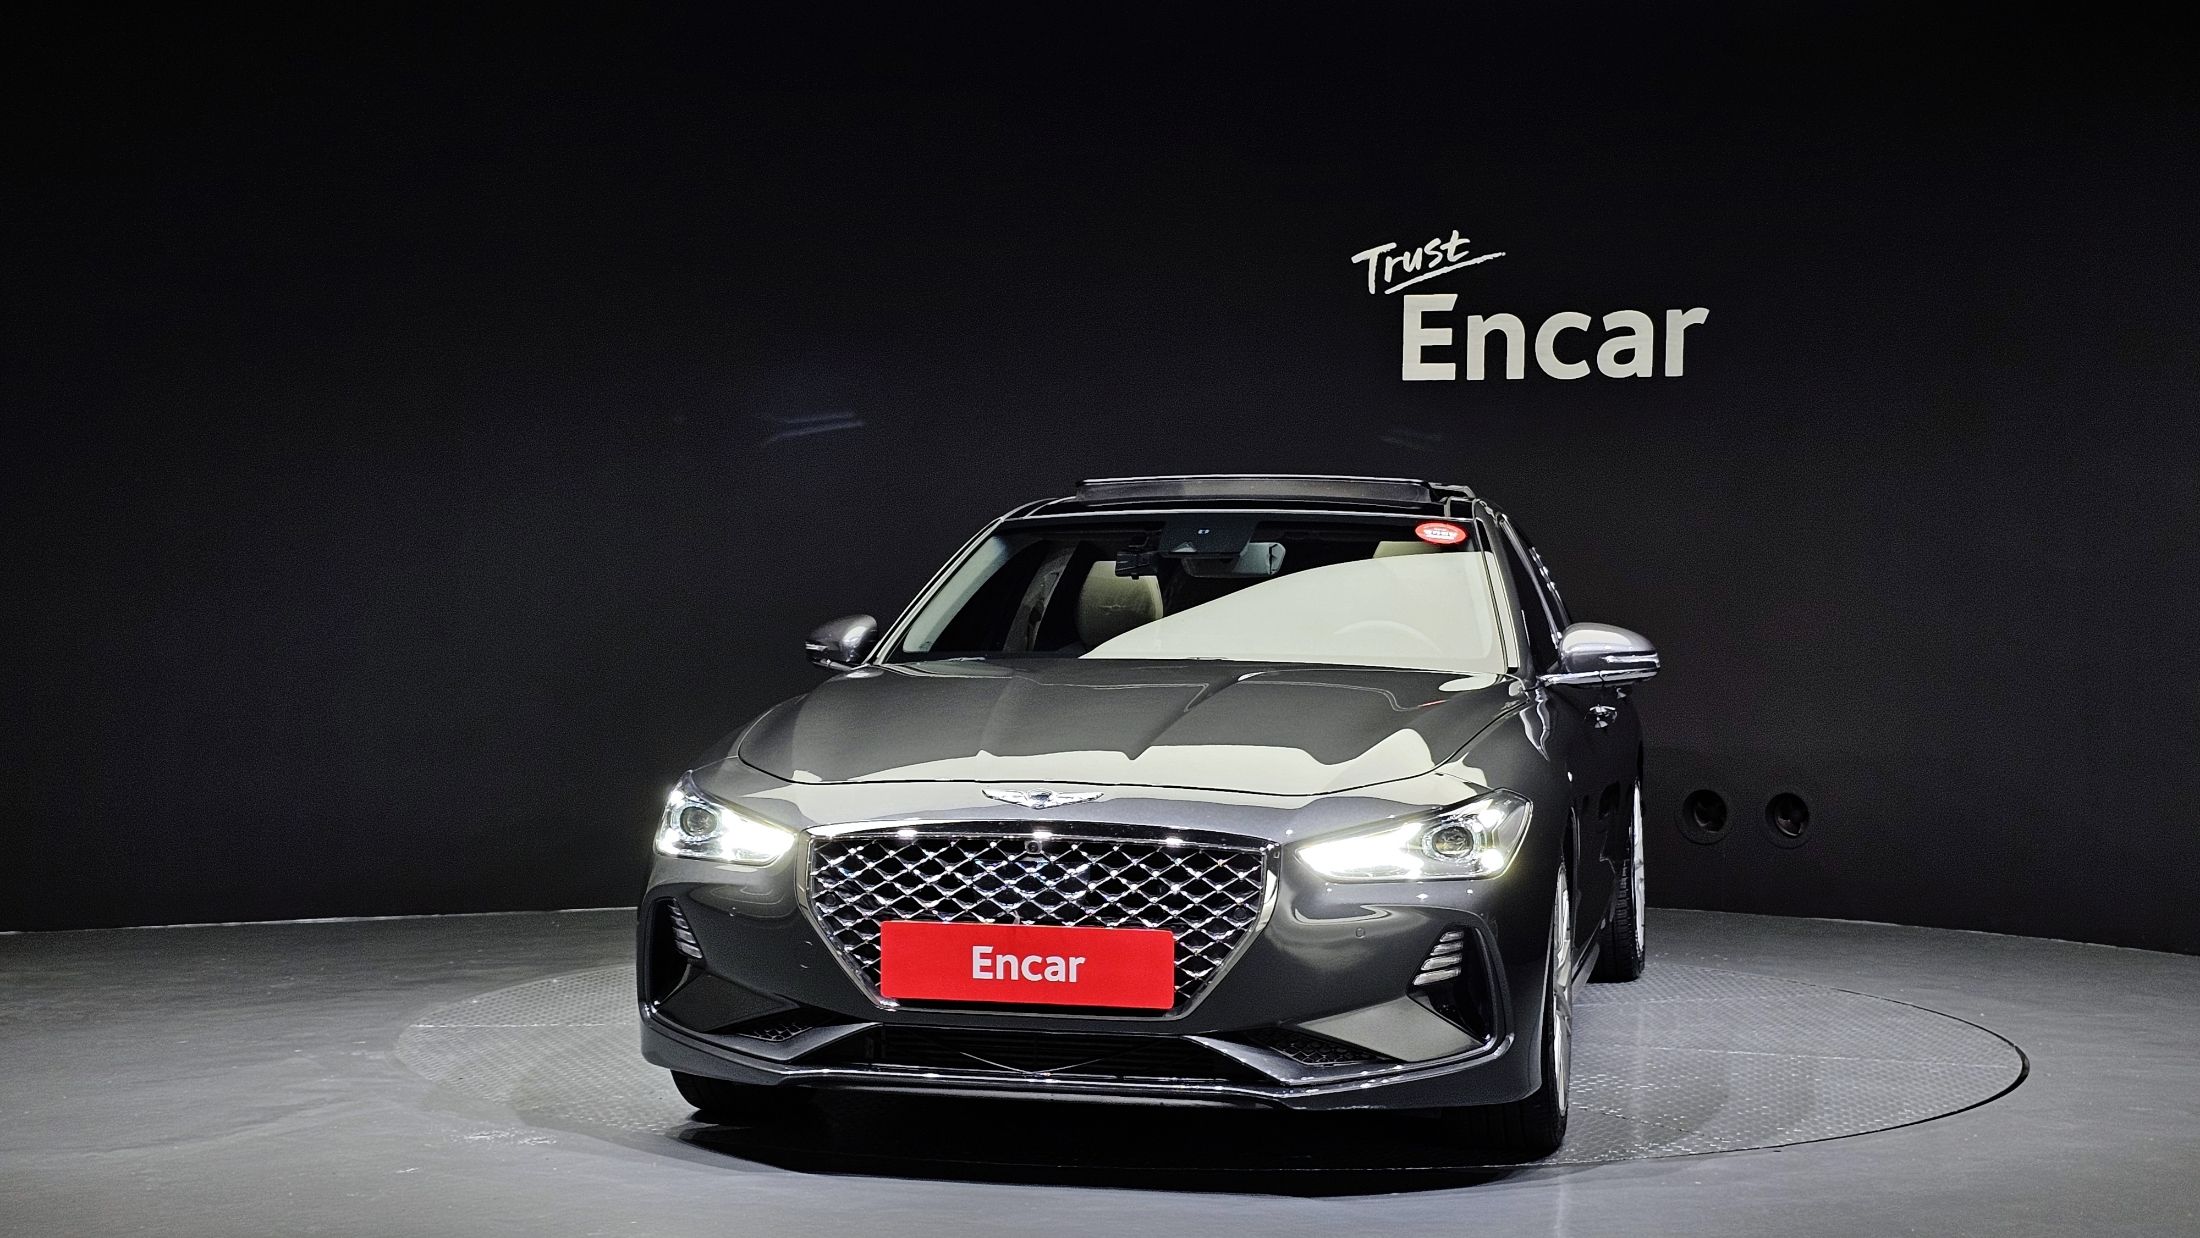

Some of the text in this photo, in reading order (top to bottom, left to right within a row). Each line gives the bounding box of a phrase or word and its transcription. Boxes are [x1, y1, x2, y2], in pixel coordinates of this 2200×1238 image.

[1350, 229, 1473, 294] Trust
[1402, 293, 1710, 381] Encar
[971, 945, 1086, 983] Encar
